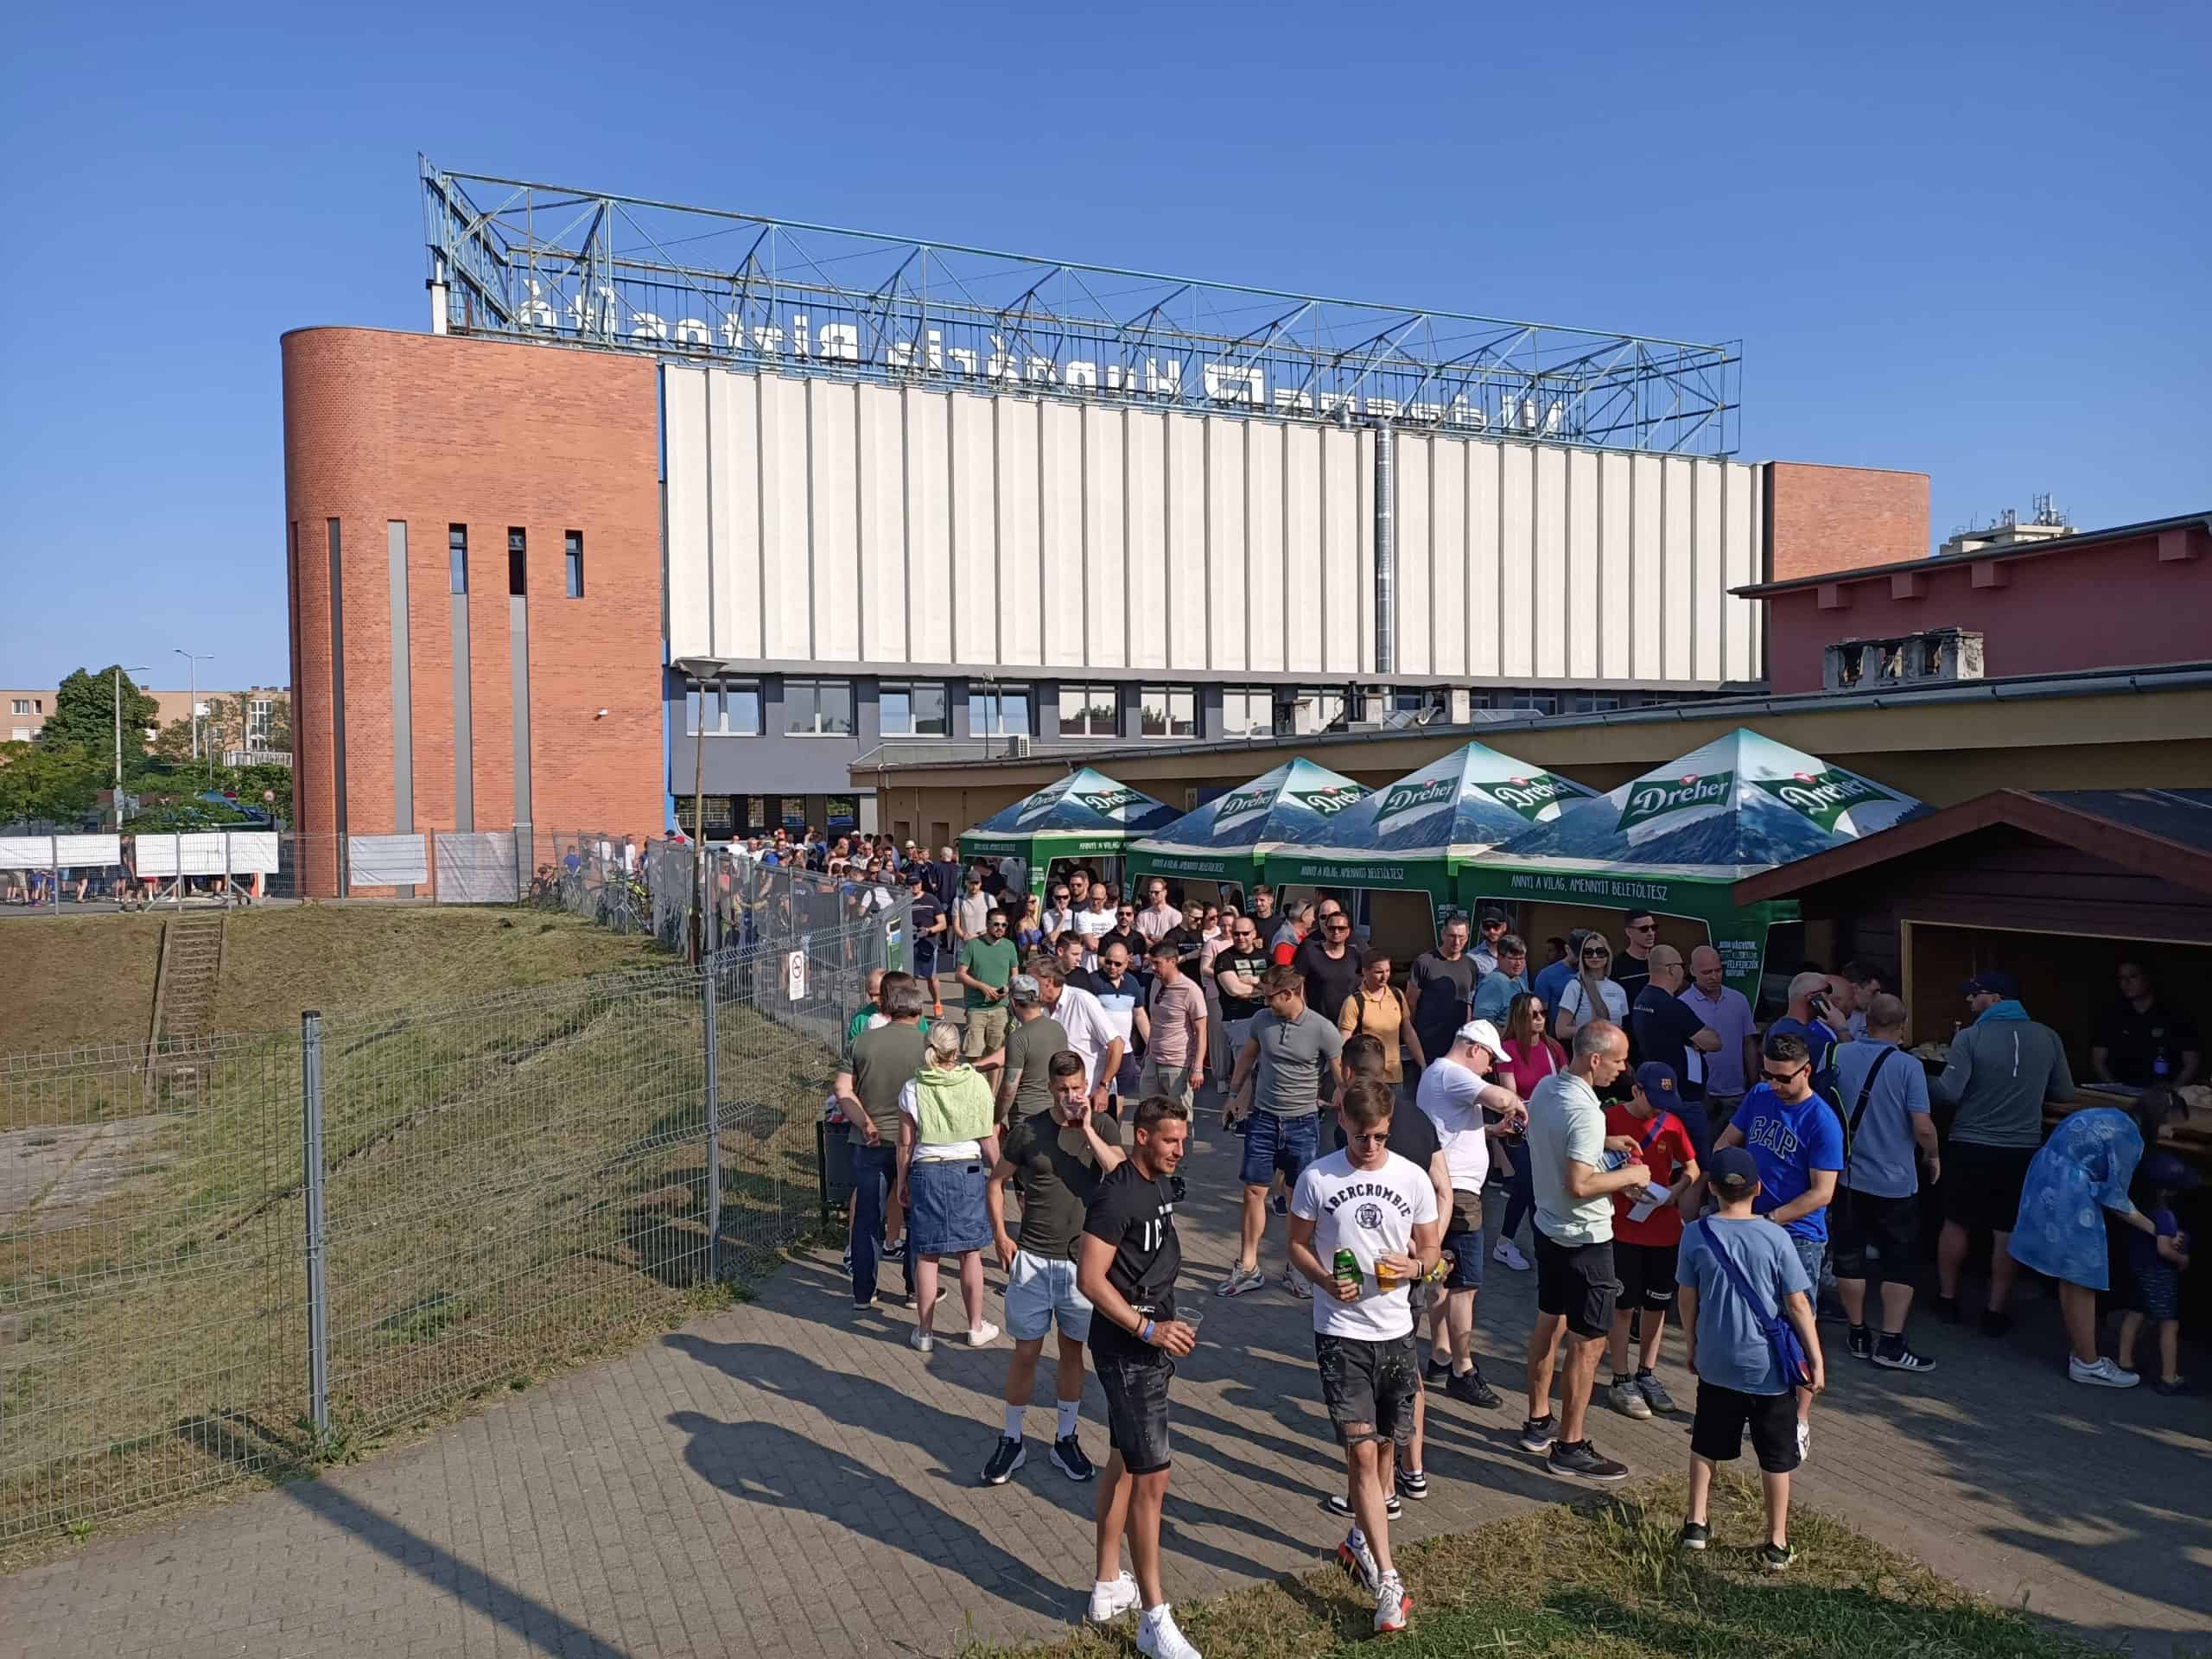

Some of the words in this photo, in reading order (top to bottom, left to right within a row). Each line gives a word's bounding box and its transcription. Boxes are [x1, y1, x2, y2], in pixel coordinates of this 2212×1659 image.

[1222, 791, 1274, 815] Dreher
[1388, 779, 1454, 812] Dreher
[1494, 779, 1573, 809] Dreher
[1630, 779, 1729, 817] Dreher
[1779, 775, 1869, 816] Dreher
[1511, 874, 1534, 888] ANNYI
[1569, 878, 1609, 894] AMENNYIT
[1611, 881, 1669, 900] BELETÖLTESZ
[1749, 1116, 1798, 1159] GAP
[1324, 1183, 1411, 1217] ABERCROMBIE
